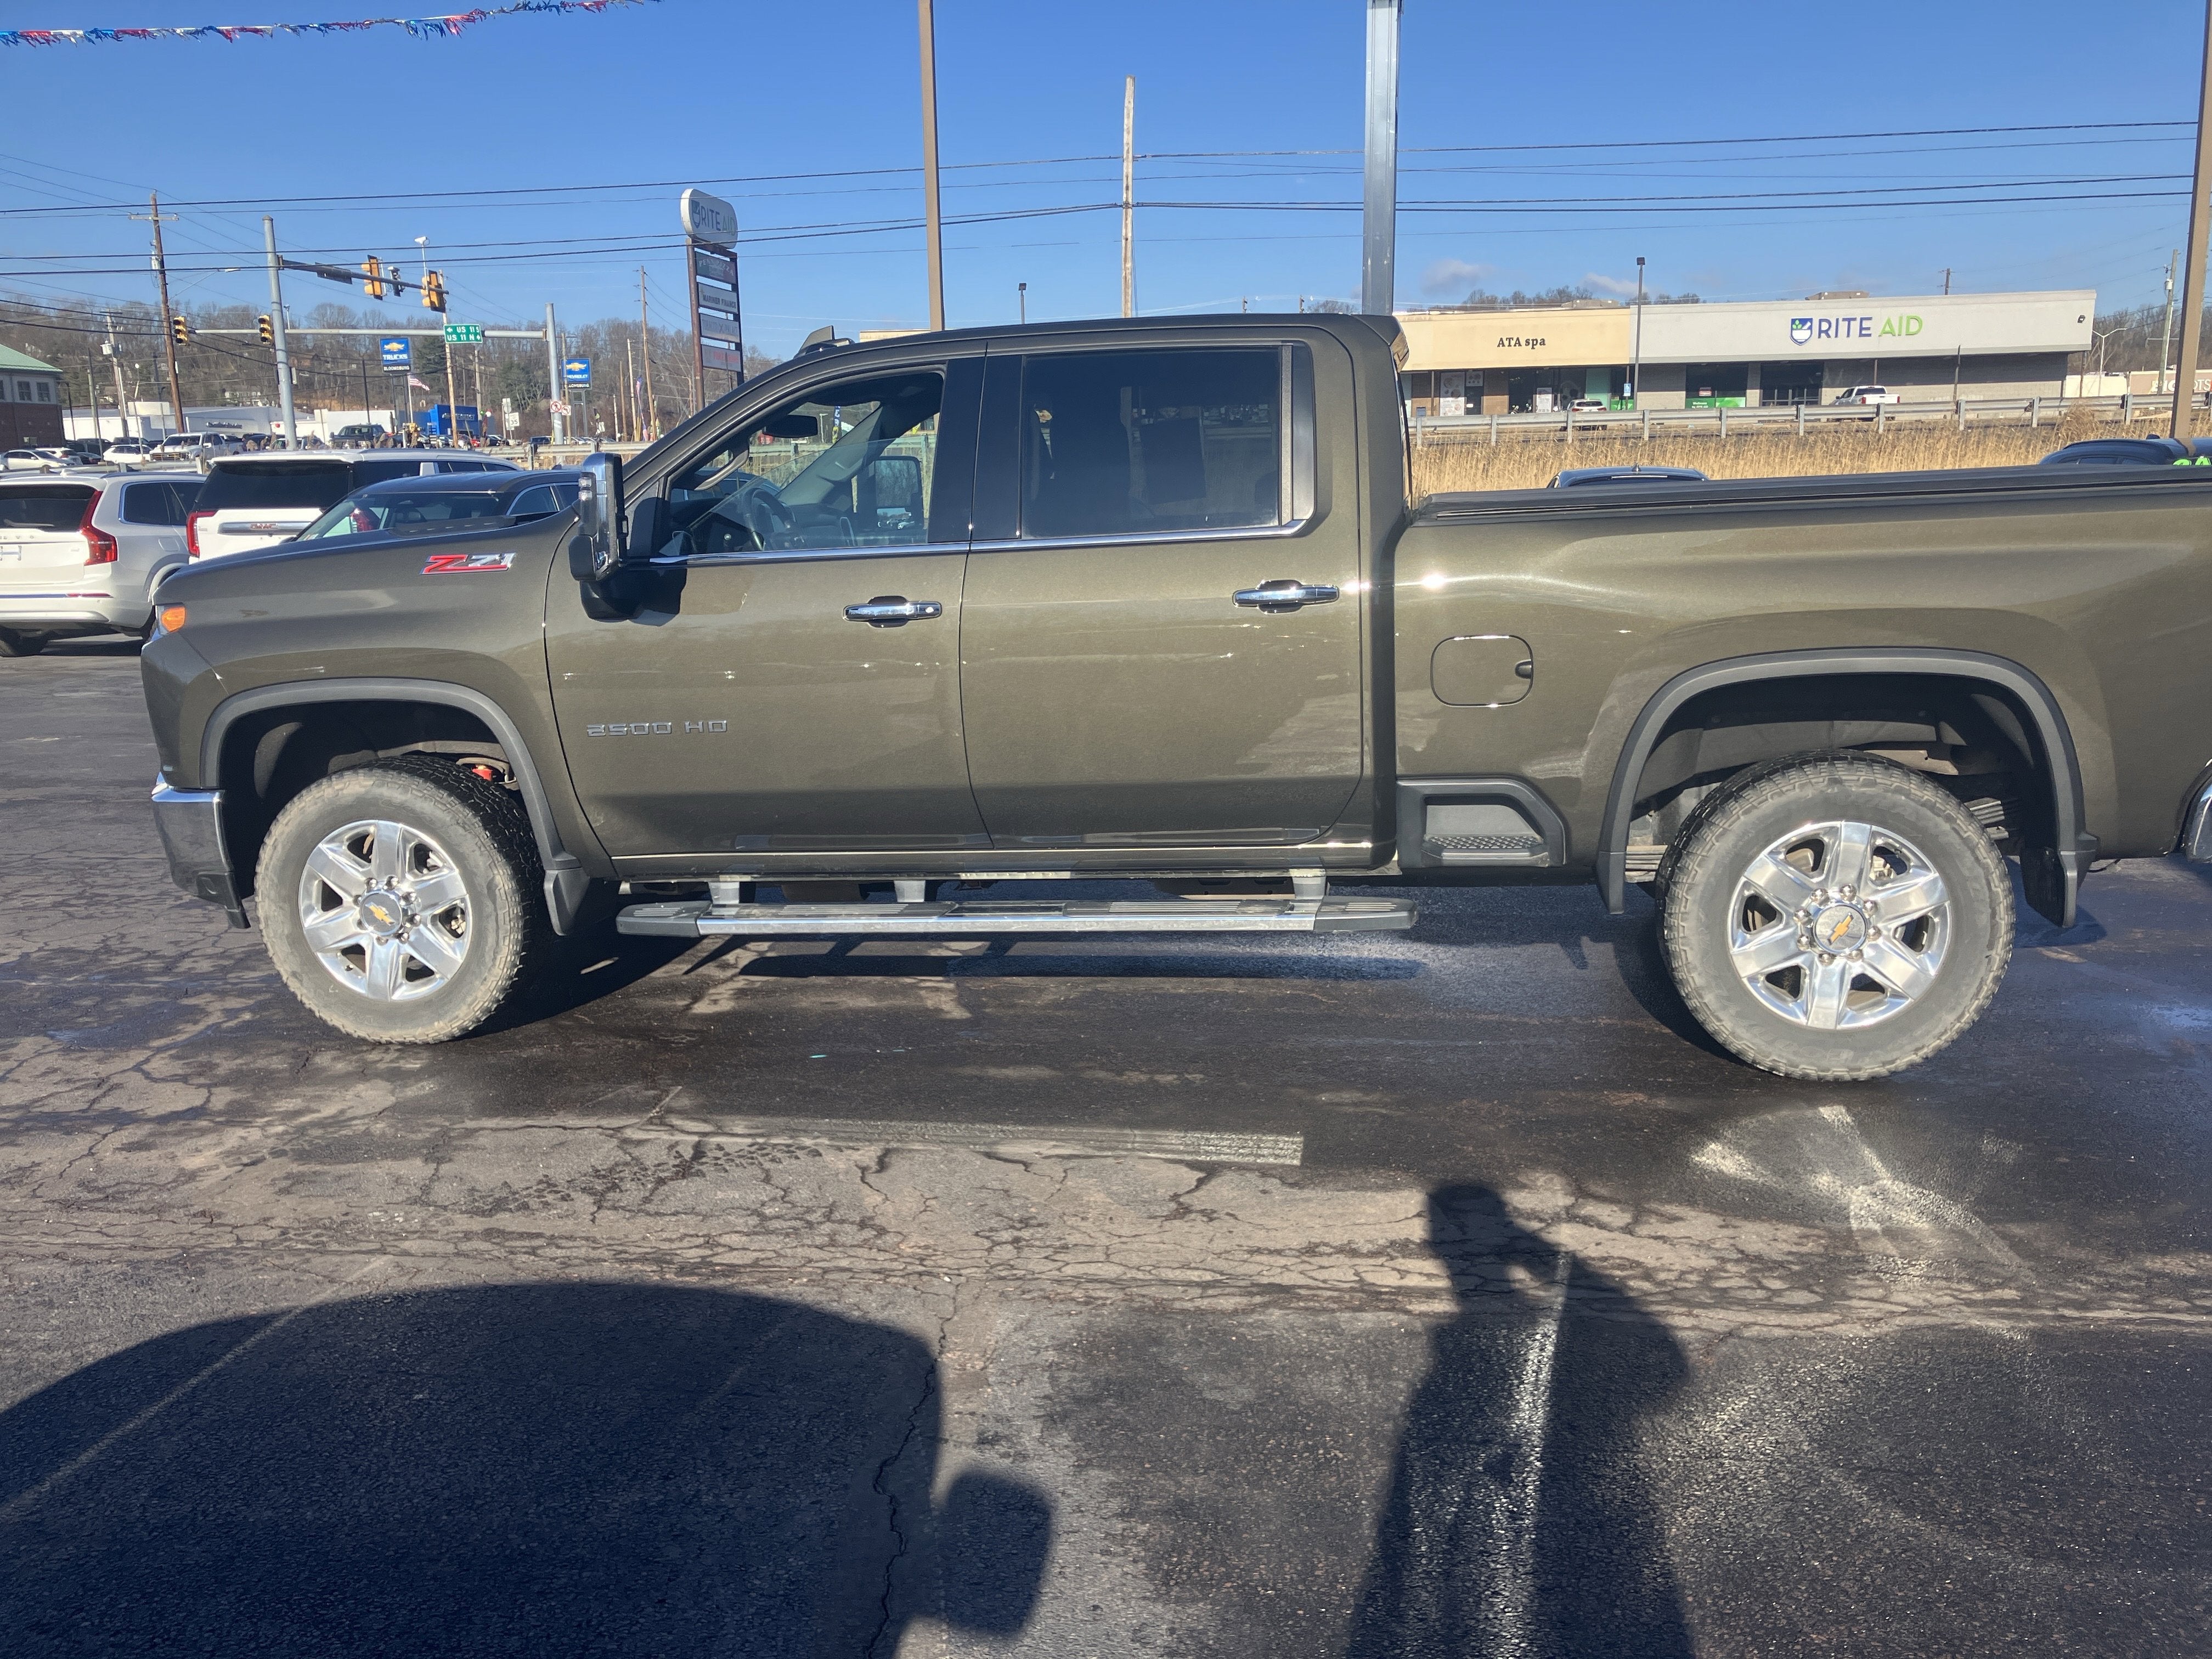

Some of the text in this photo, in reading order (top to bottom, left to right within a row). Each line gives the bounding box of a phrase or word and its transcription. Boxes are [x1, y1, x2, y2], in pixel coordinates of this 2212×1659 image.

[701, 205, 721, 232] RITE
[1818, 315, 1923, 339] RITE AID
[1497, 337, 1546, 349] ATA spa
[420, 552, 516, 575] Z71
[586, 720, 727, 737] 2500 HD
